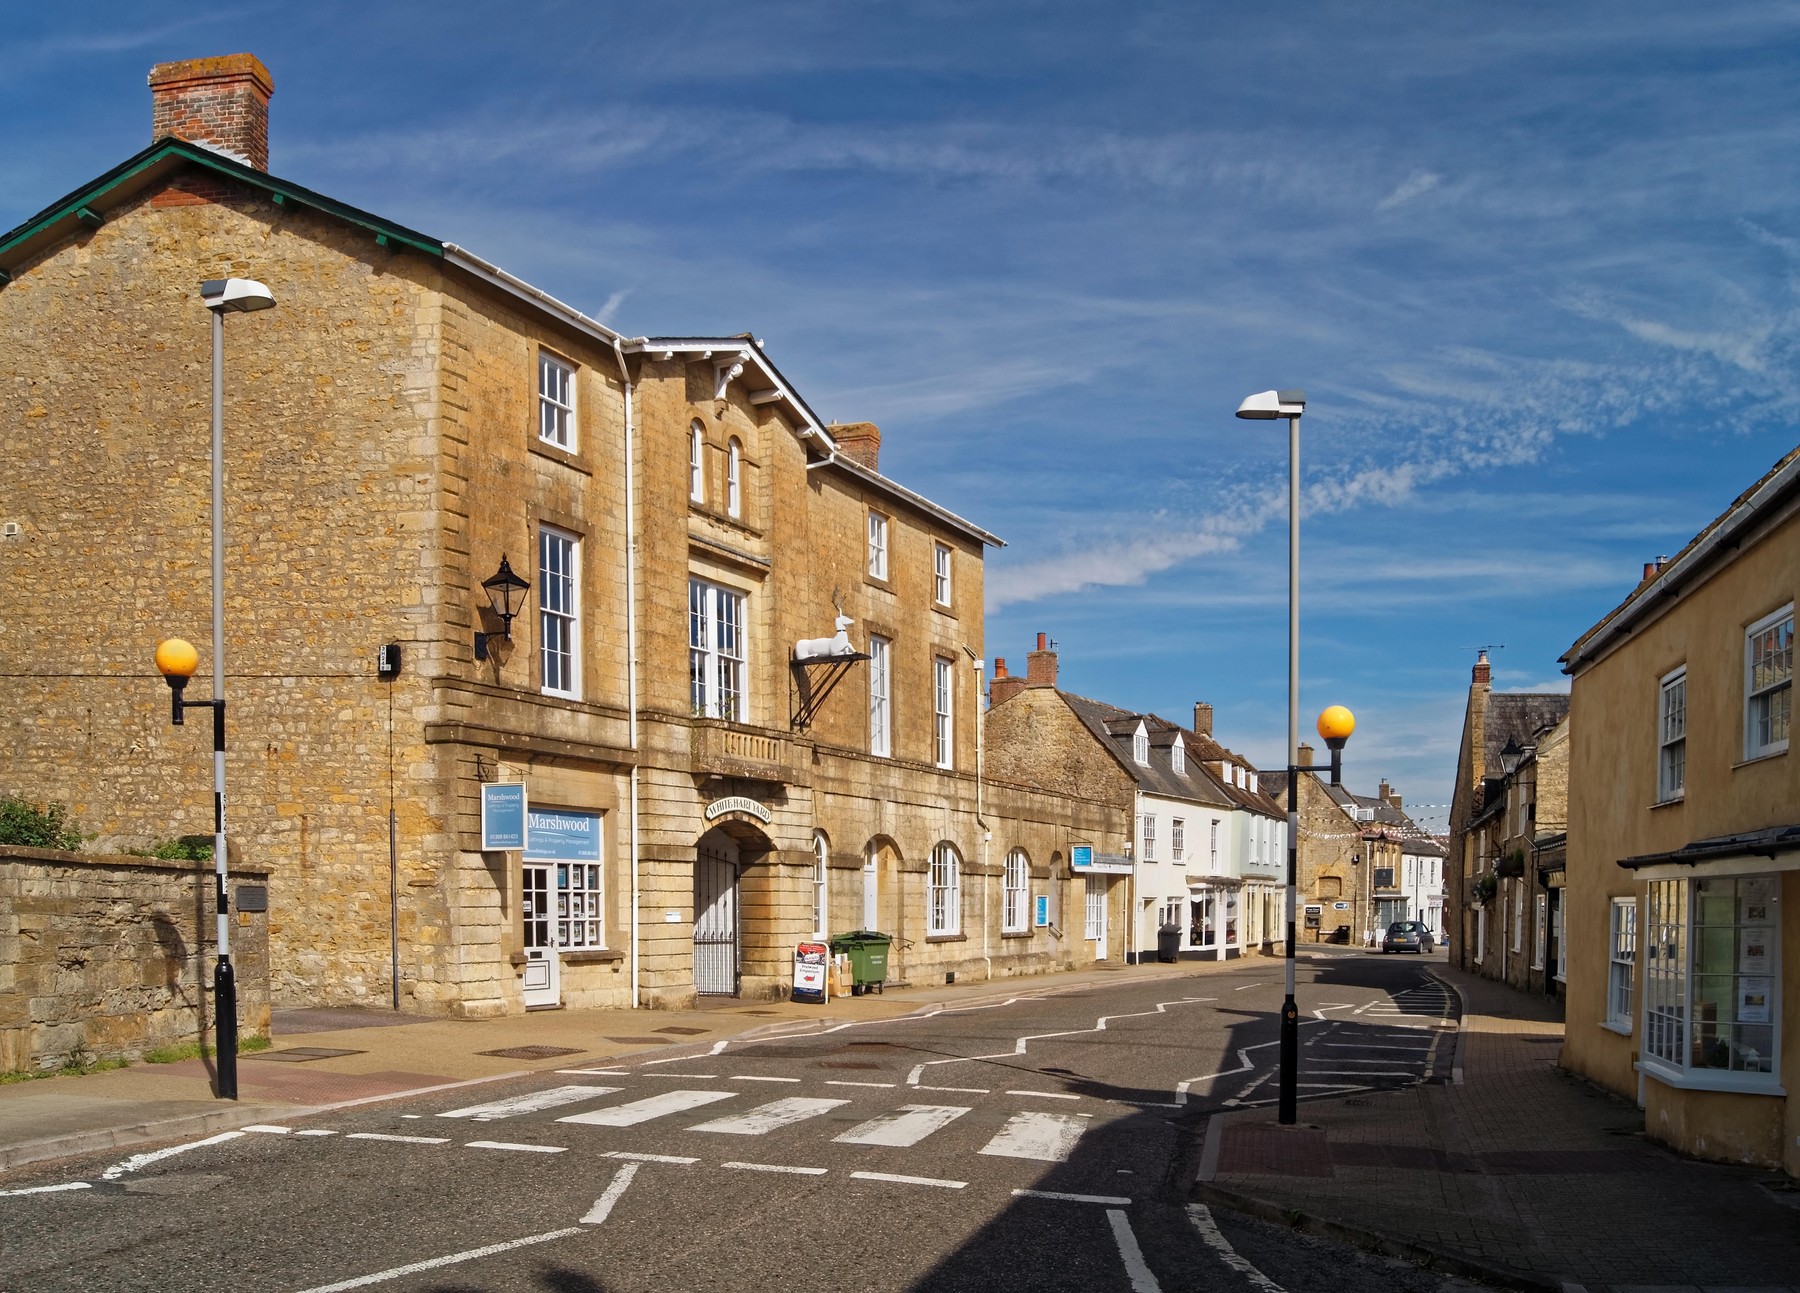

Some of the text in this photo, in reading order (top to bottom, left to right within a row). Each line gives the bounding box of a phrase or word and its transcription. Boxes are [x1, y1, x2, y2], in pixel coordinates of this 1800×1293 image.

[488, 793, 520, 801] Marshwood
[709, 798, 770, 820] WHITE HART YARD
[528, 814, 589, 831] Marshwood
